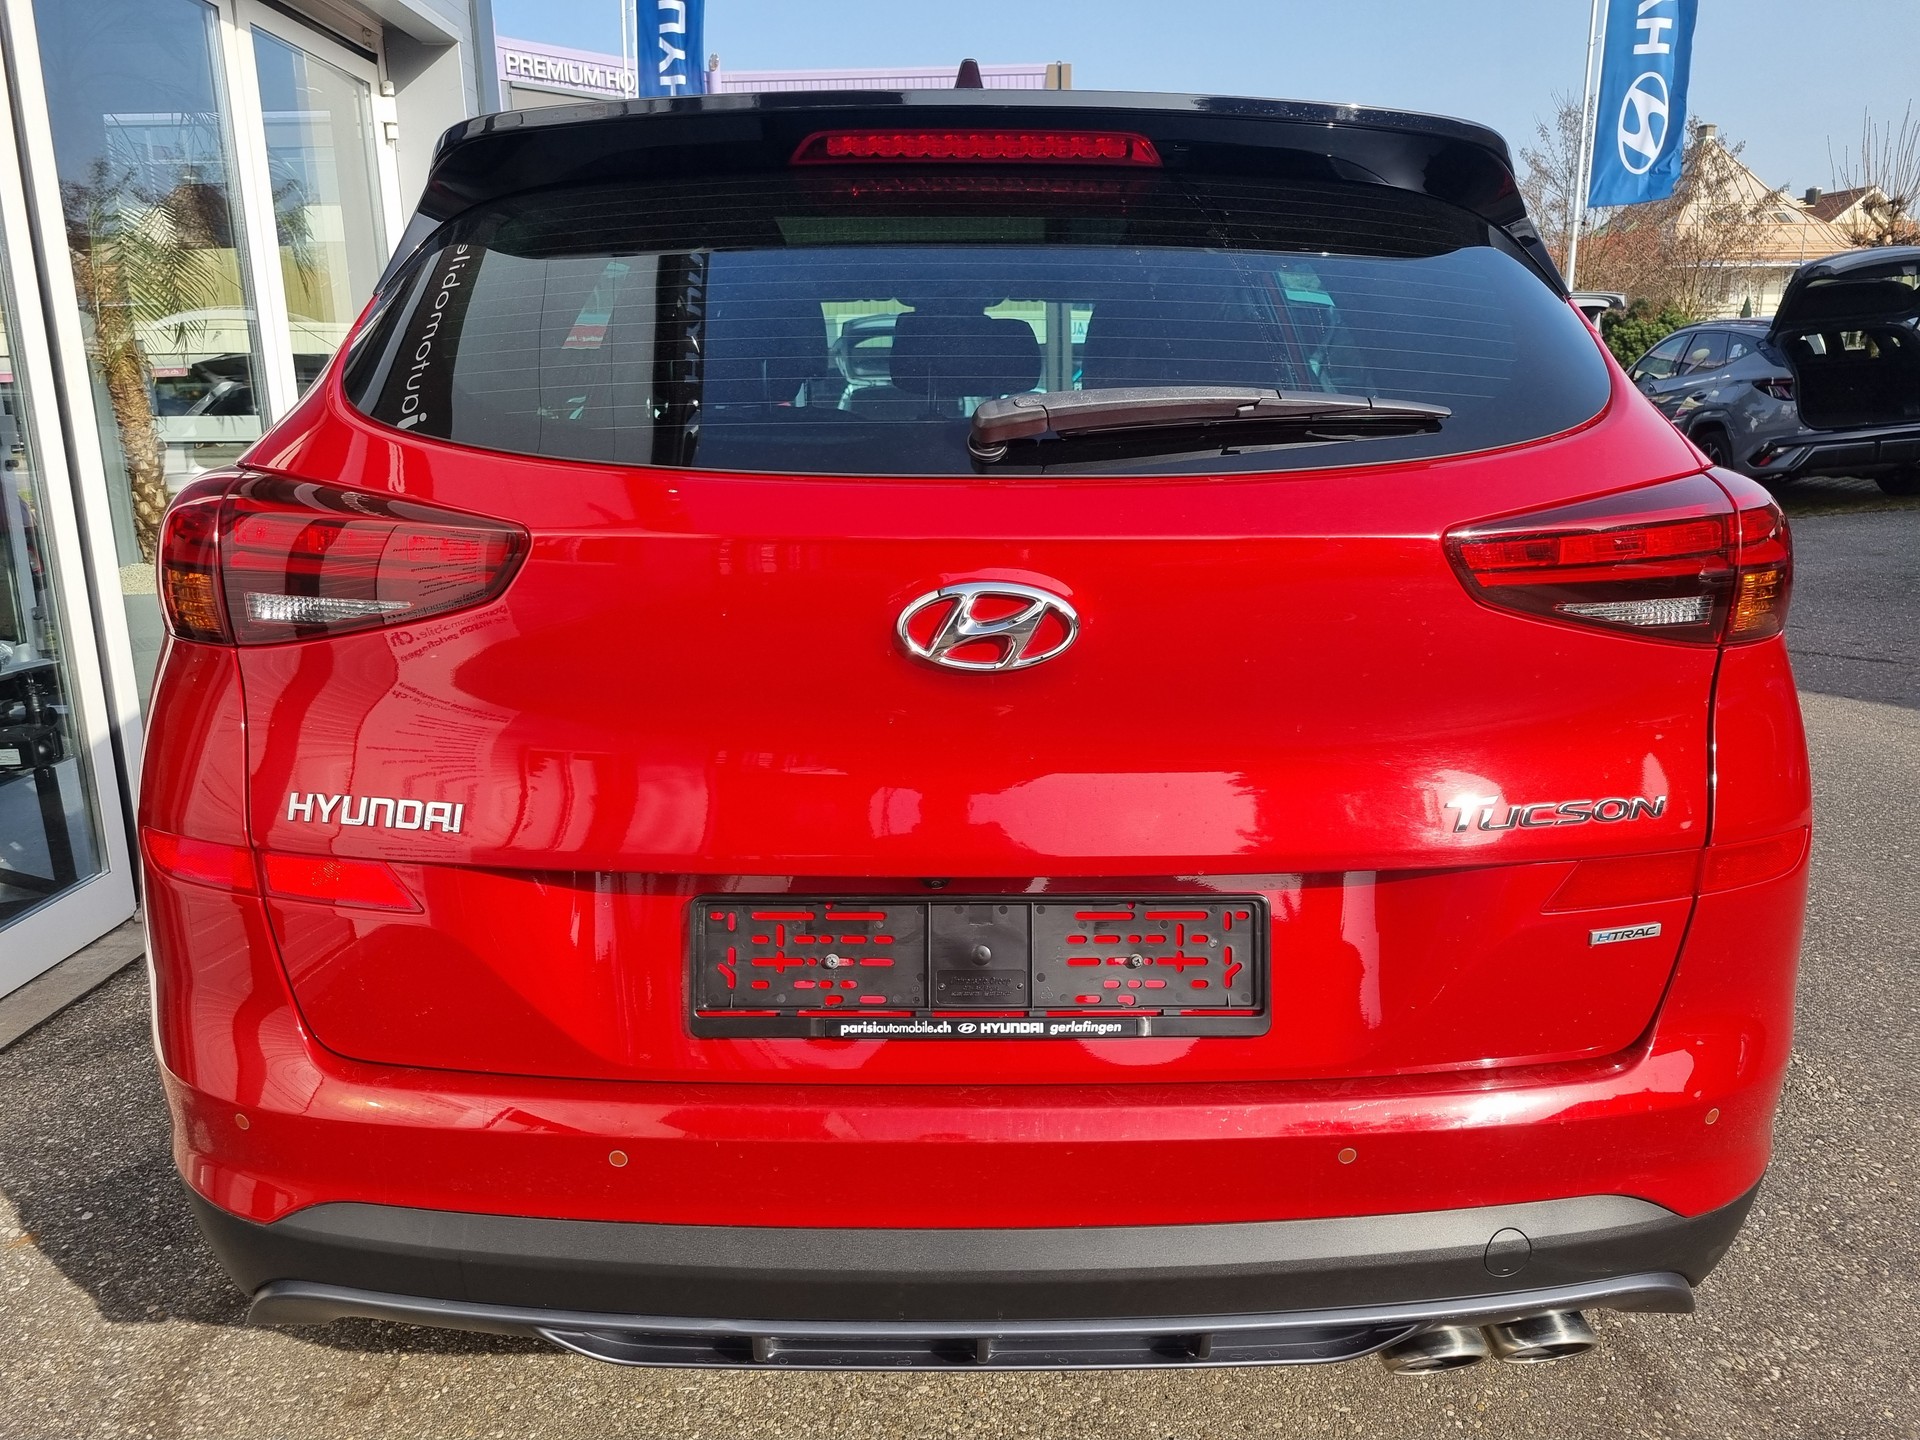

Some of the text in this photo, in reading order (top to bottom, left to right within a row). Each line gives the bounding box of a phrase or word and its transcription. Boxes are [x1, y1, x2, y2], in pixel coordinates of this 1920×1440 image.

[504, 53, 600, 90] PREMIUM
[287, 792, 465, 834] HYUNDAI
[1444, 795, 1667, 834] TUCSON
[1596, 925, 1657, 942] HTRAC
[840, 1020, 1122, 1037] parisiautomobile.ch HYUNDAI gerlafingen
